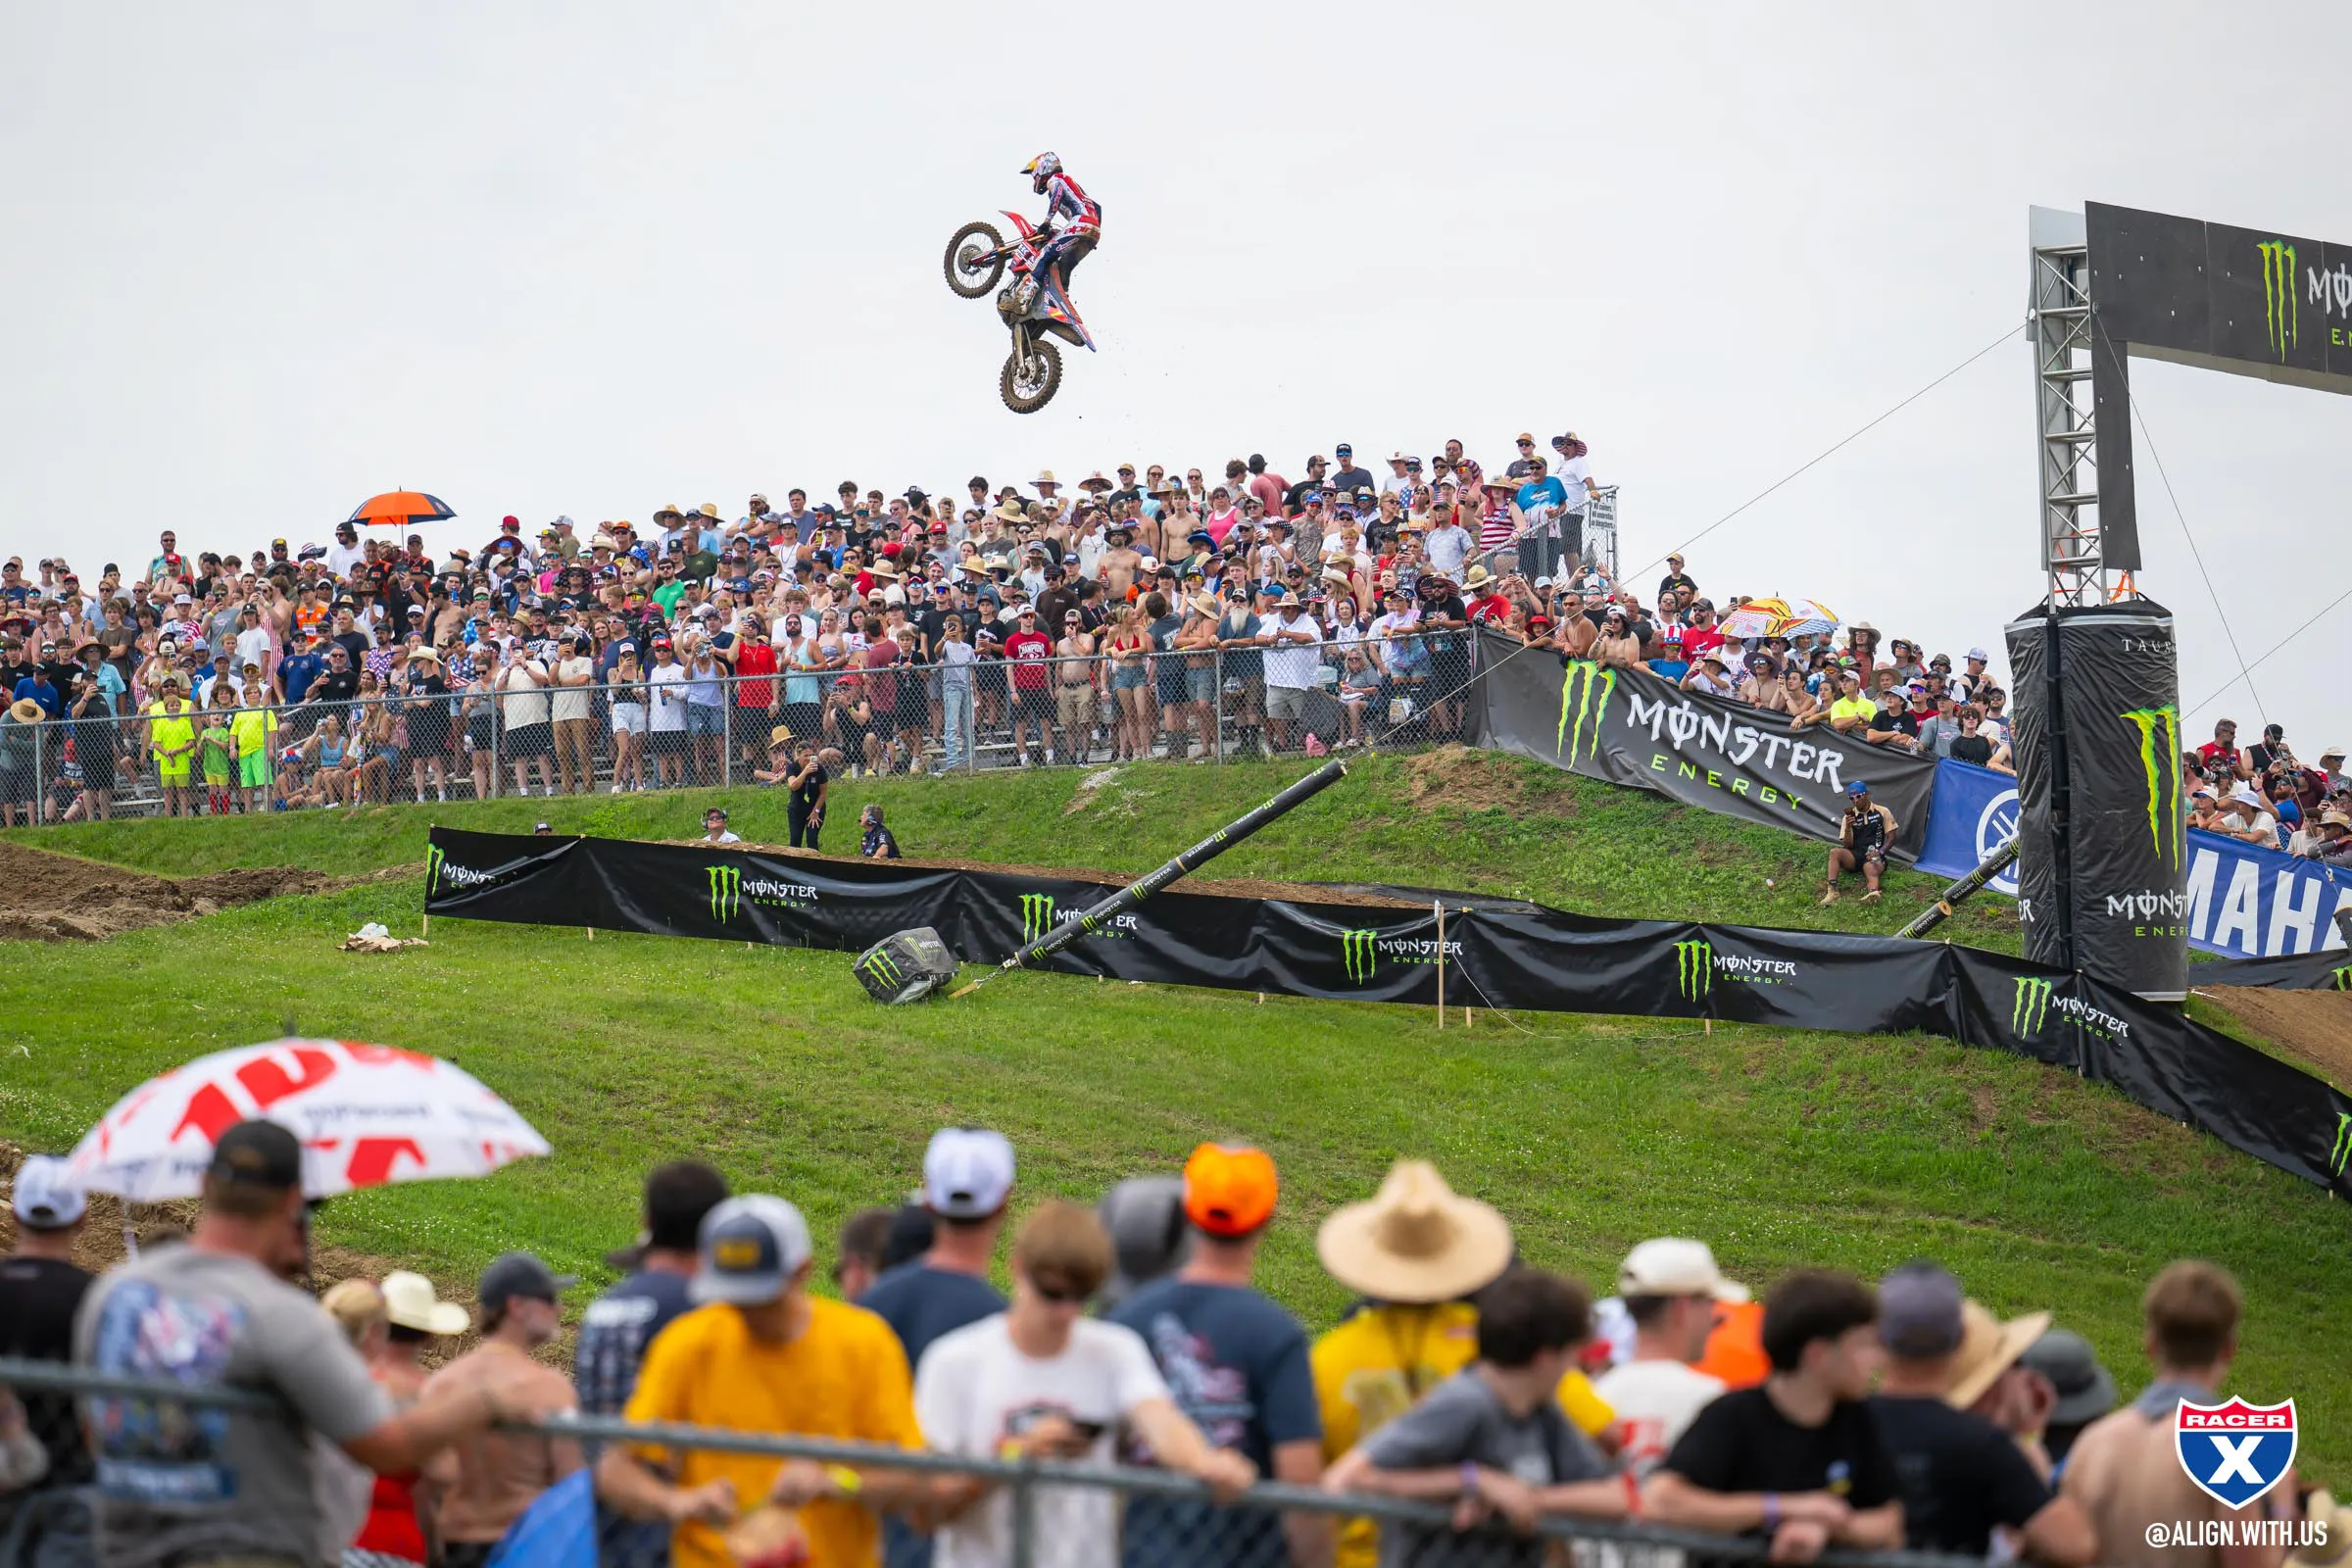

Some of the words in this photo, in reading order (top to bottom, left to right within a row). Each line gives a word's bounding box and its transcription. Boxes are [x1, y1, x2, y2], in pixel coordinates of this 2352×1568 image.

[1627, 693, 1844, 794] MONSTER
[1650, 754, 1803, 810] ENERGY
[742, 879, 818, 901] MONSTER
[754, 898, 807, 907] ENERGY
[2134, 926, 2187, 937] ENER
[1713, 955, 1796, 976] MONSTER
[1724, 973, 1782, 985] ENERGY
[2052, 996, 2129, 1037] MONSTER
